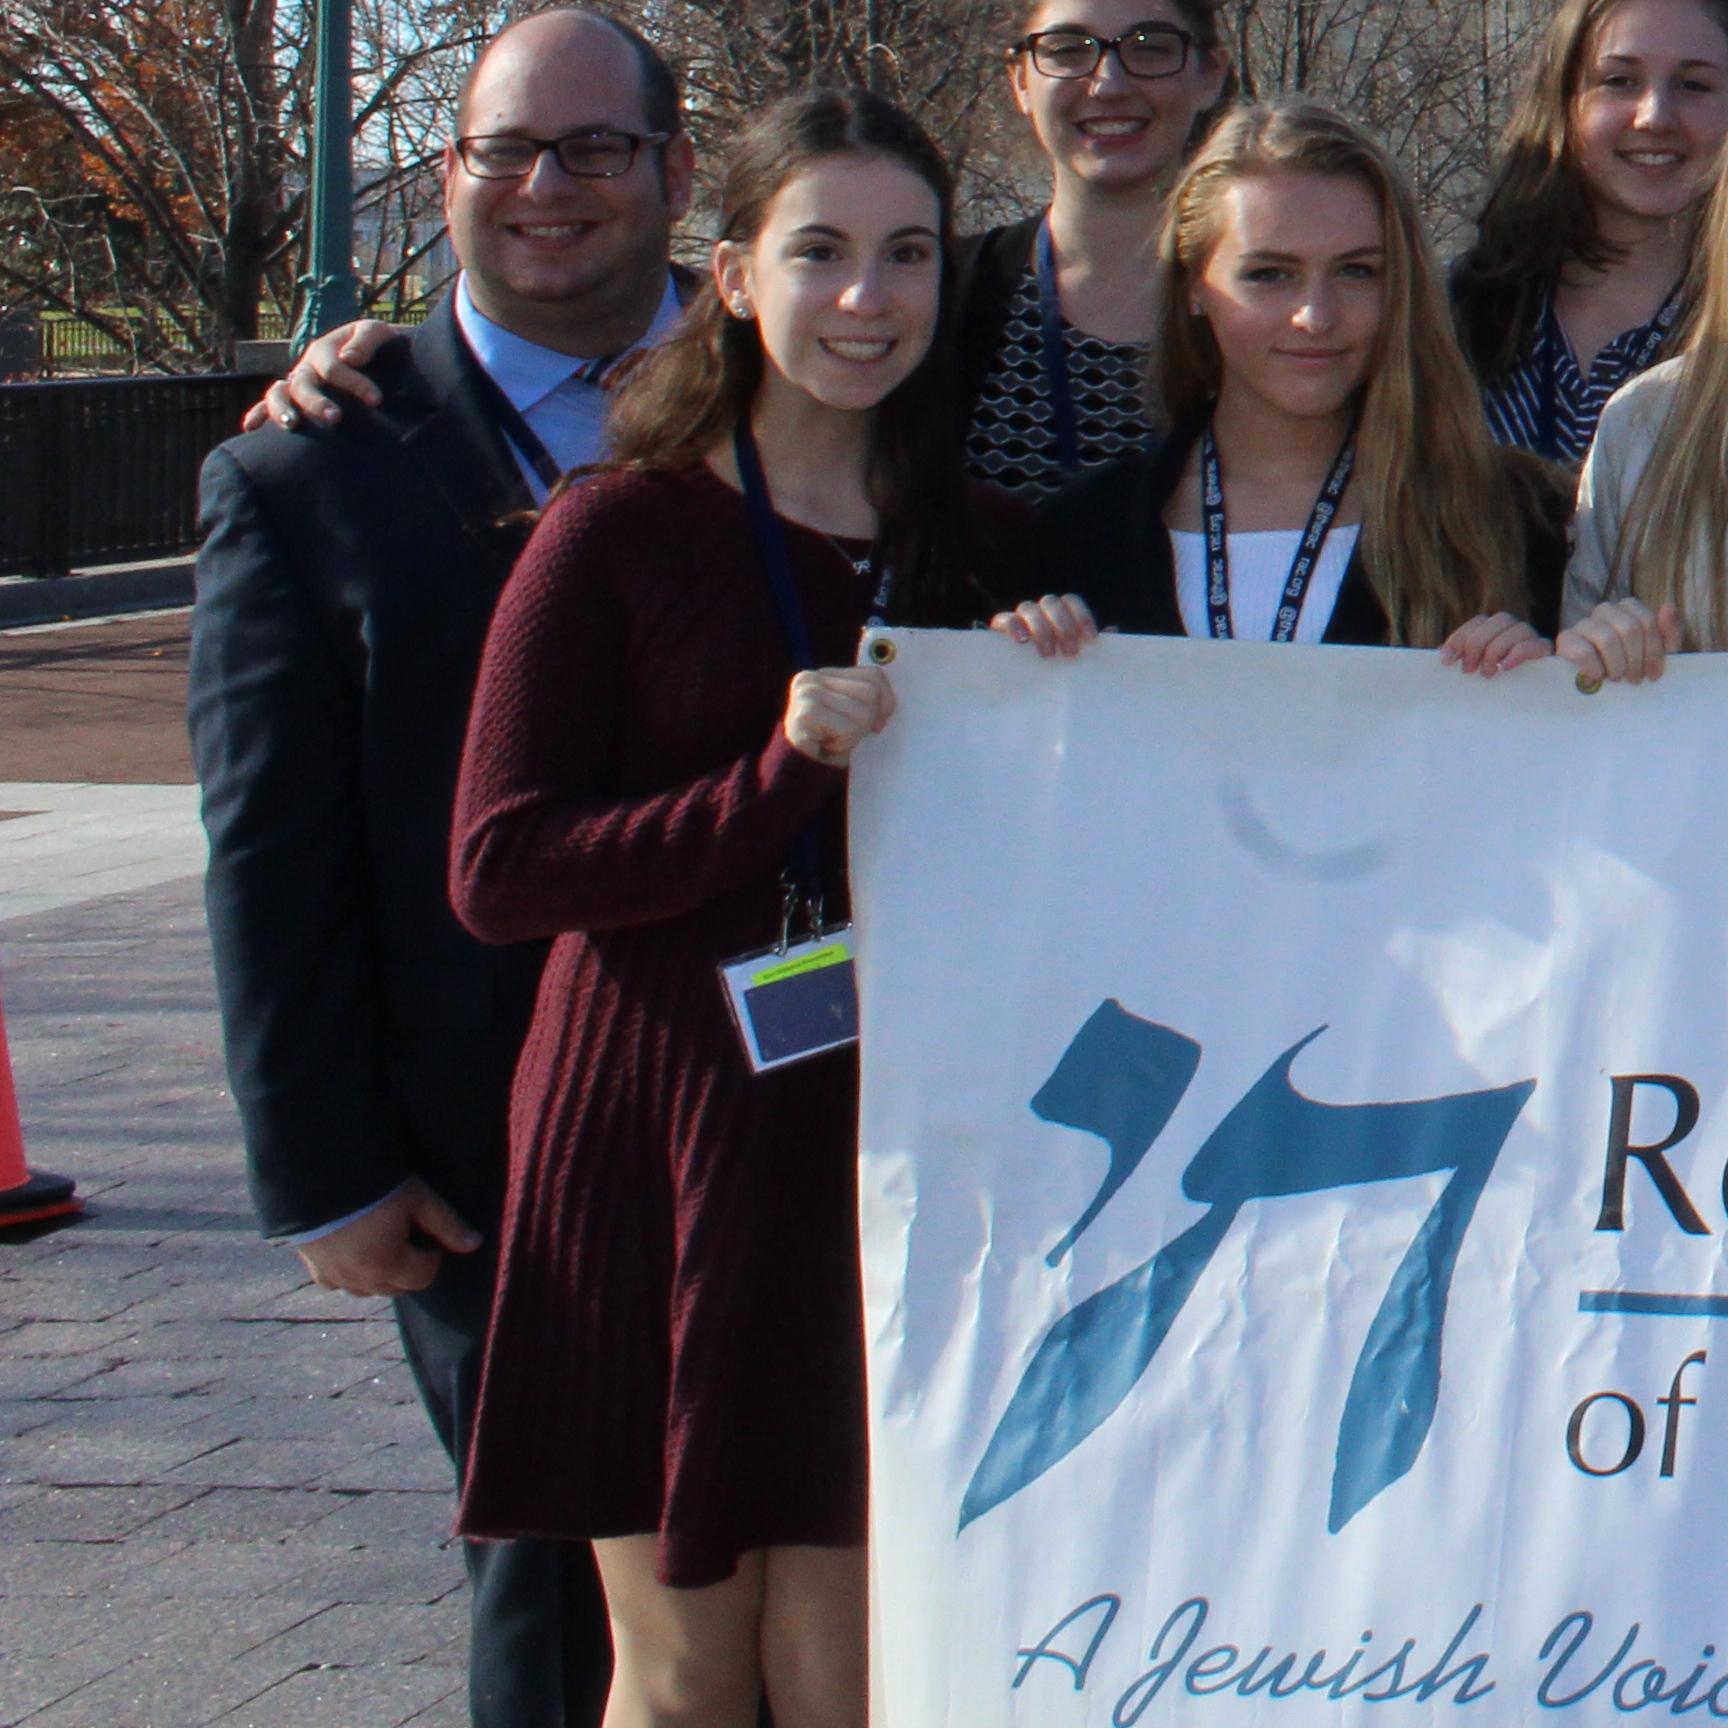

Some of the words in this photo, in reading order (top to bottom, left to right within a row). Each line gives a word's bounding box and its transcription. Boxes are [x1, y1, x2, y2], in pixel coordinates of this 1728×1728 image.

[1209, 513, 1225, 552] rac.org
[1304, 501, 1335, 549] @therac
[1209, 558, 1229, 606] @therac
[1286, 557, 1310, 597] rac.org
[1566, 1353, 1706, 1479] of
[1011, 1595, 1120, 1692] A
[1112, 1599, 1496, 1728] Jewish
